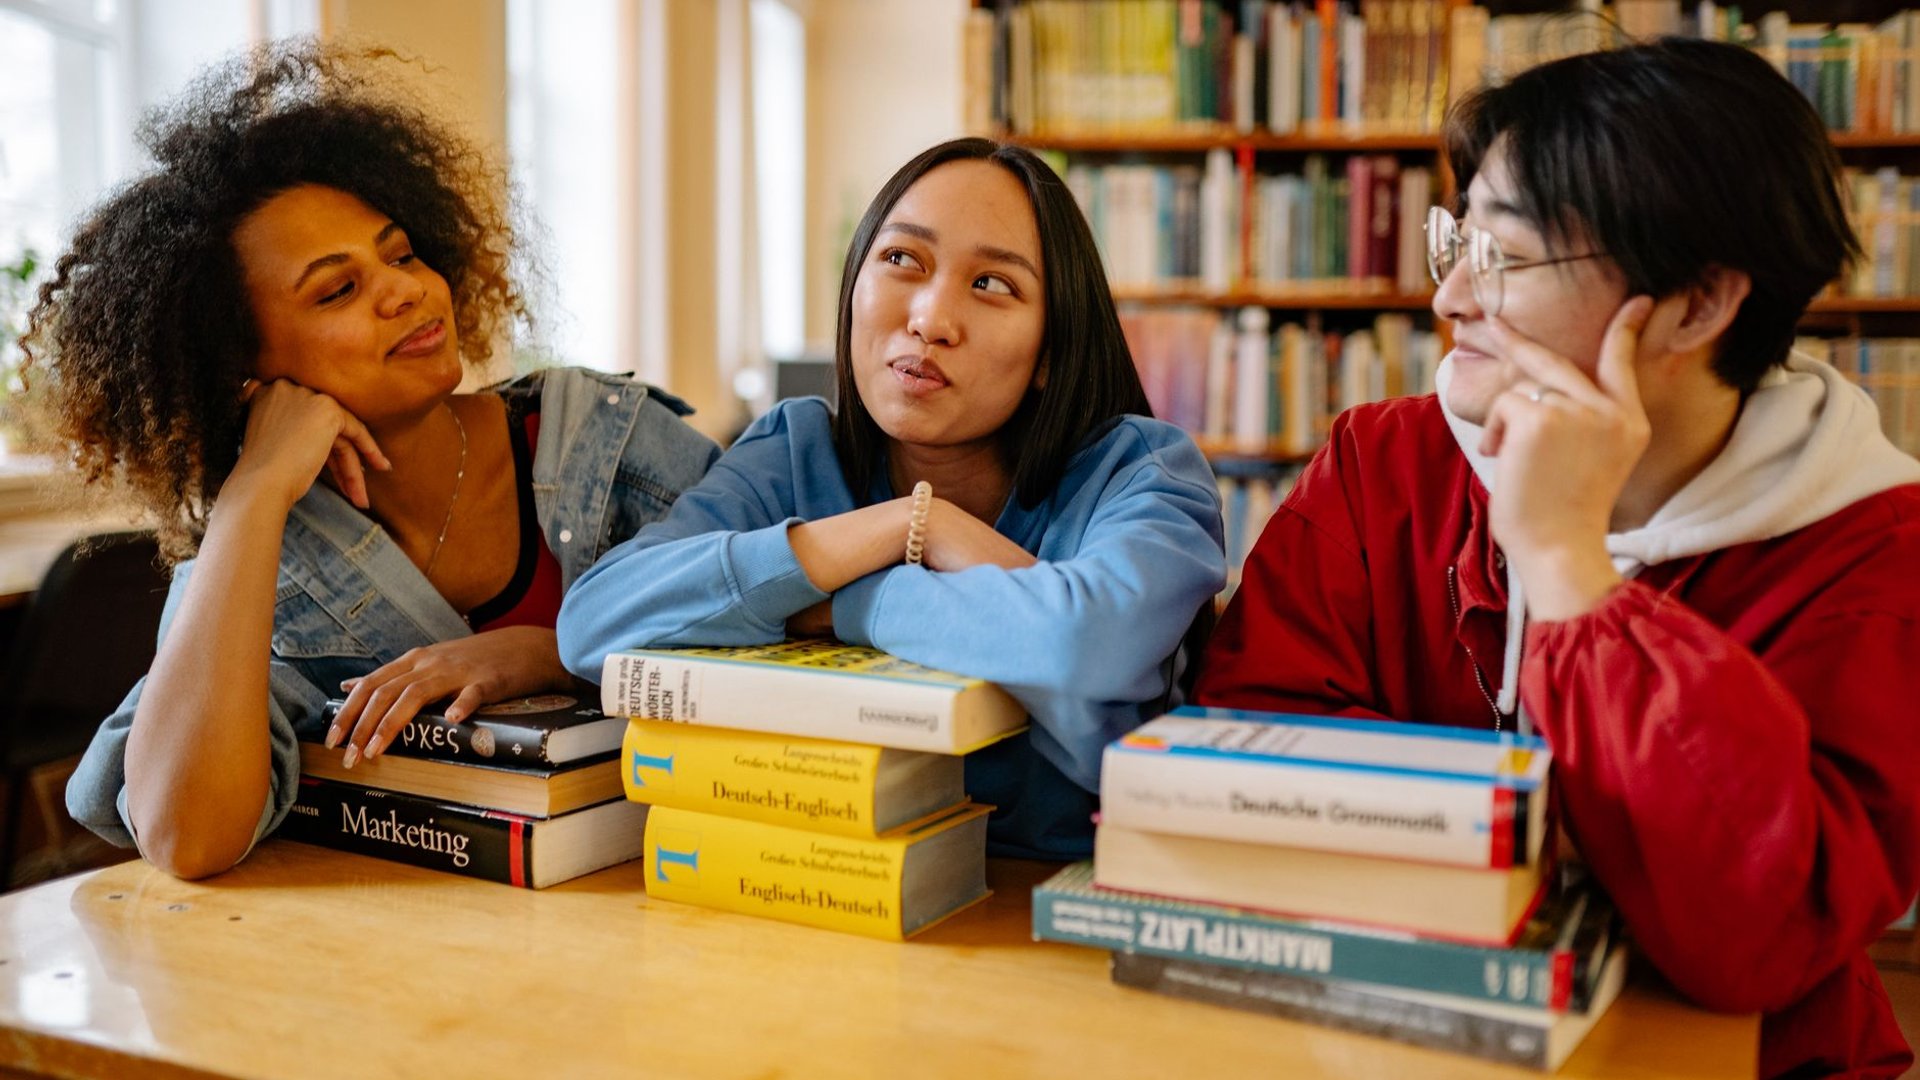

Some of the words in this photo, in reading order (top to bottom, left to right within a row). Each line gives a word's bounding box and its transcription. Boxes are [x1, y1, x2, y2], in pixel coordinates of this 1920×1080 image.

[630, 659, 645, 718] DEUTSCHE
[645, 666, 661, 719] WÖRTER-
[662, 690, 674, 722] BUCH
[402, 722, 460, 754] ρχες
[712, 781, 858, 821] Deutsch-Englisch
[1230, 790, 1321, 821] Deutsche
[1328, 800, 1447, 834] Grammatik
[341, 802, 470, 867] Marketing
[739, 878, 890, 919] Englisch-Deutsch
[1138, 910, 1333, 974] MARKTPLATZ
